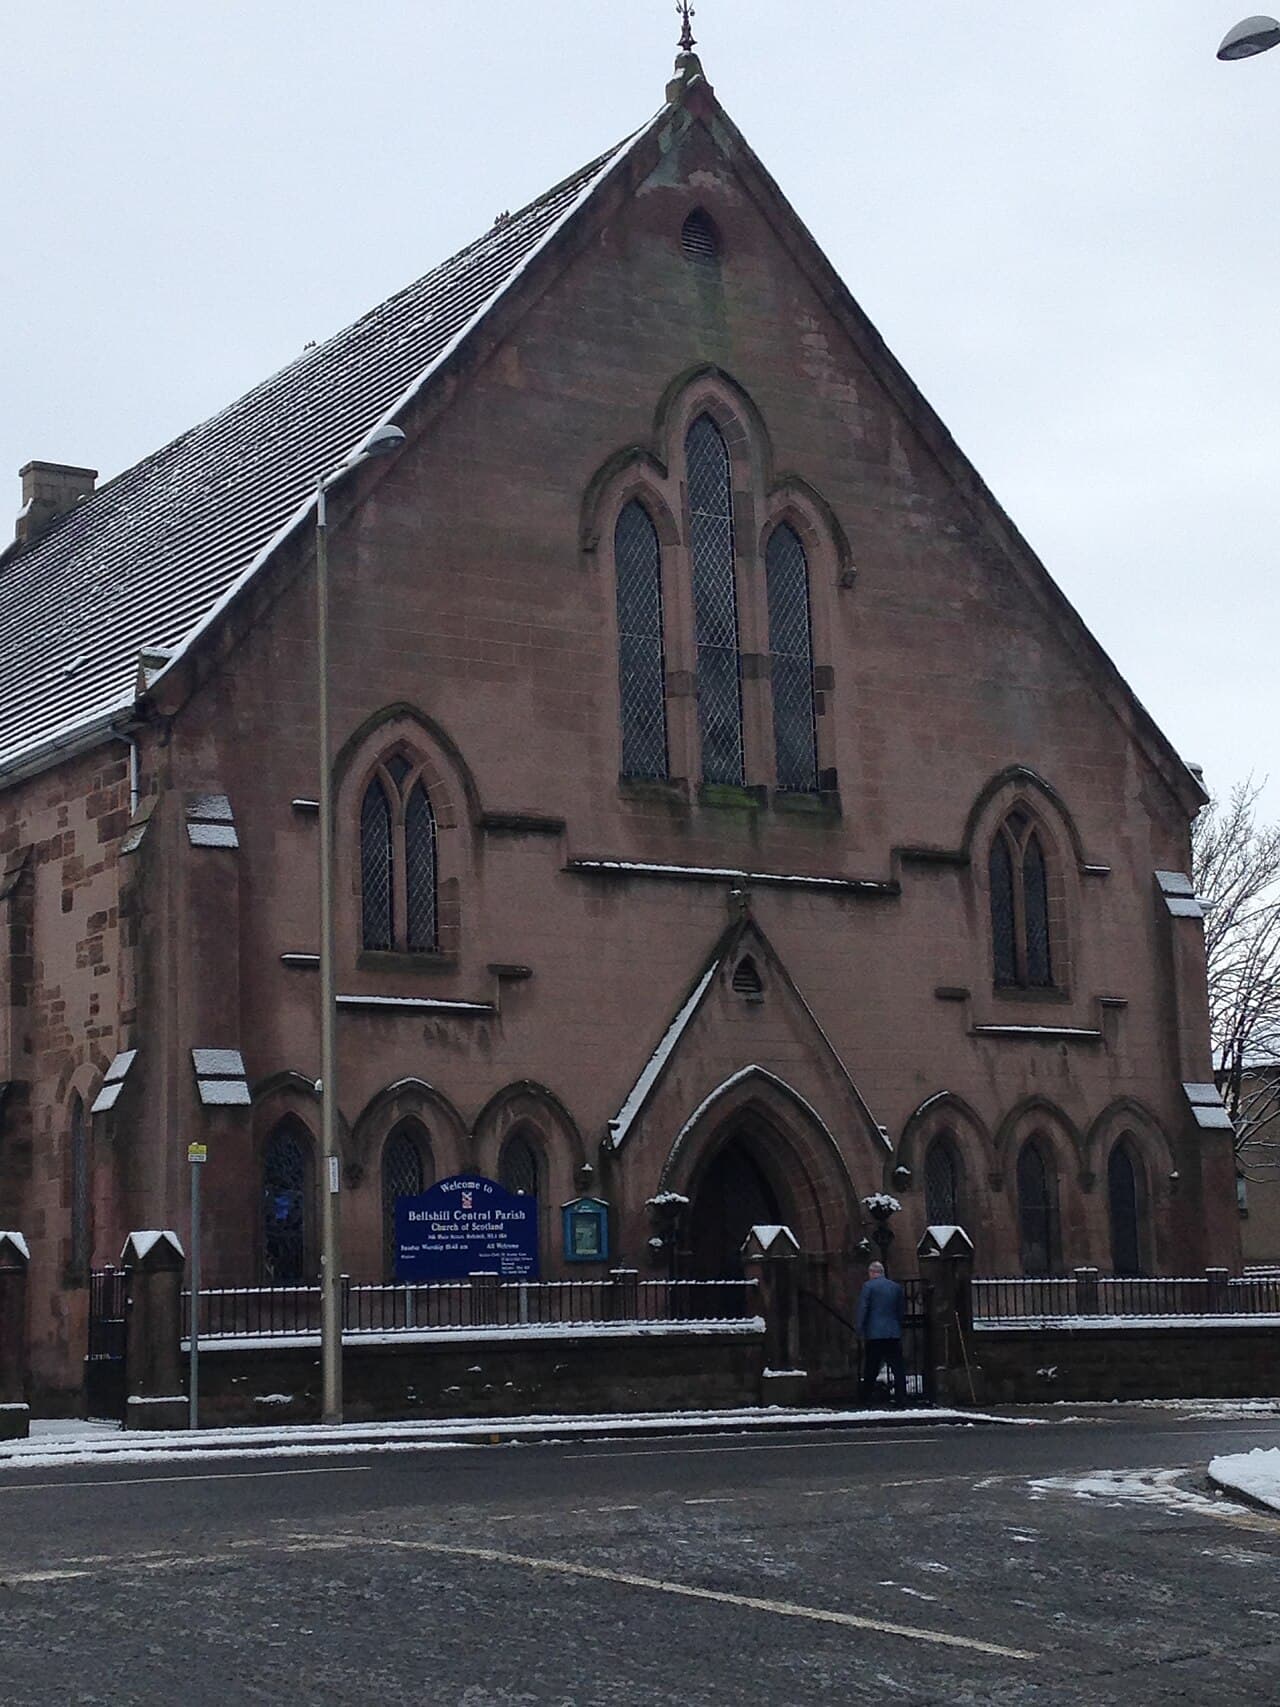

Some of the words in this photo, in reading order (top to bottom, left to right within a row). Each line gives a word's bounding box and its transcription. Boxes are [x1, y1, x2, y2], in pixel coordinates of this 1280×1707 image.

[440, 1181, 480, 1193] Welcome
[483, 1184, 493, 1194] to
[408, 1211, 450, 1221] Bellshill
[453, 1210, 490, 1220] Central
[495, 1210, 526, 1220] Parish
[431, 1223, 459, 1232] Church
[461, 1222, 469, 1231] of
[472, 1222, 504, 1231] Scotland
